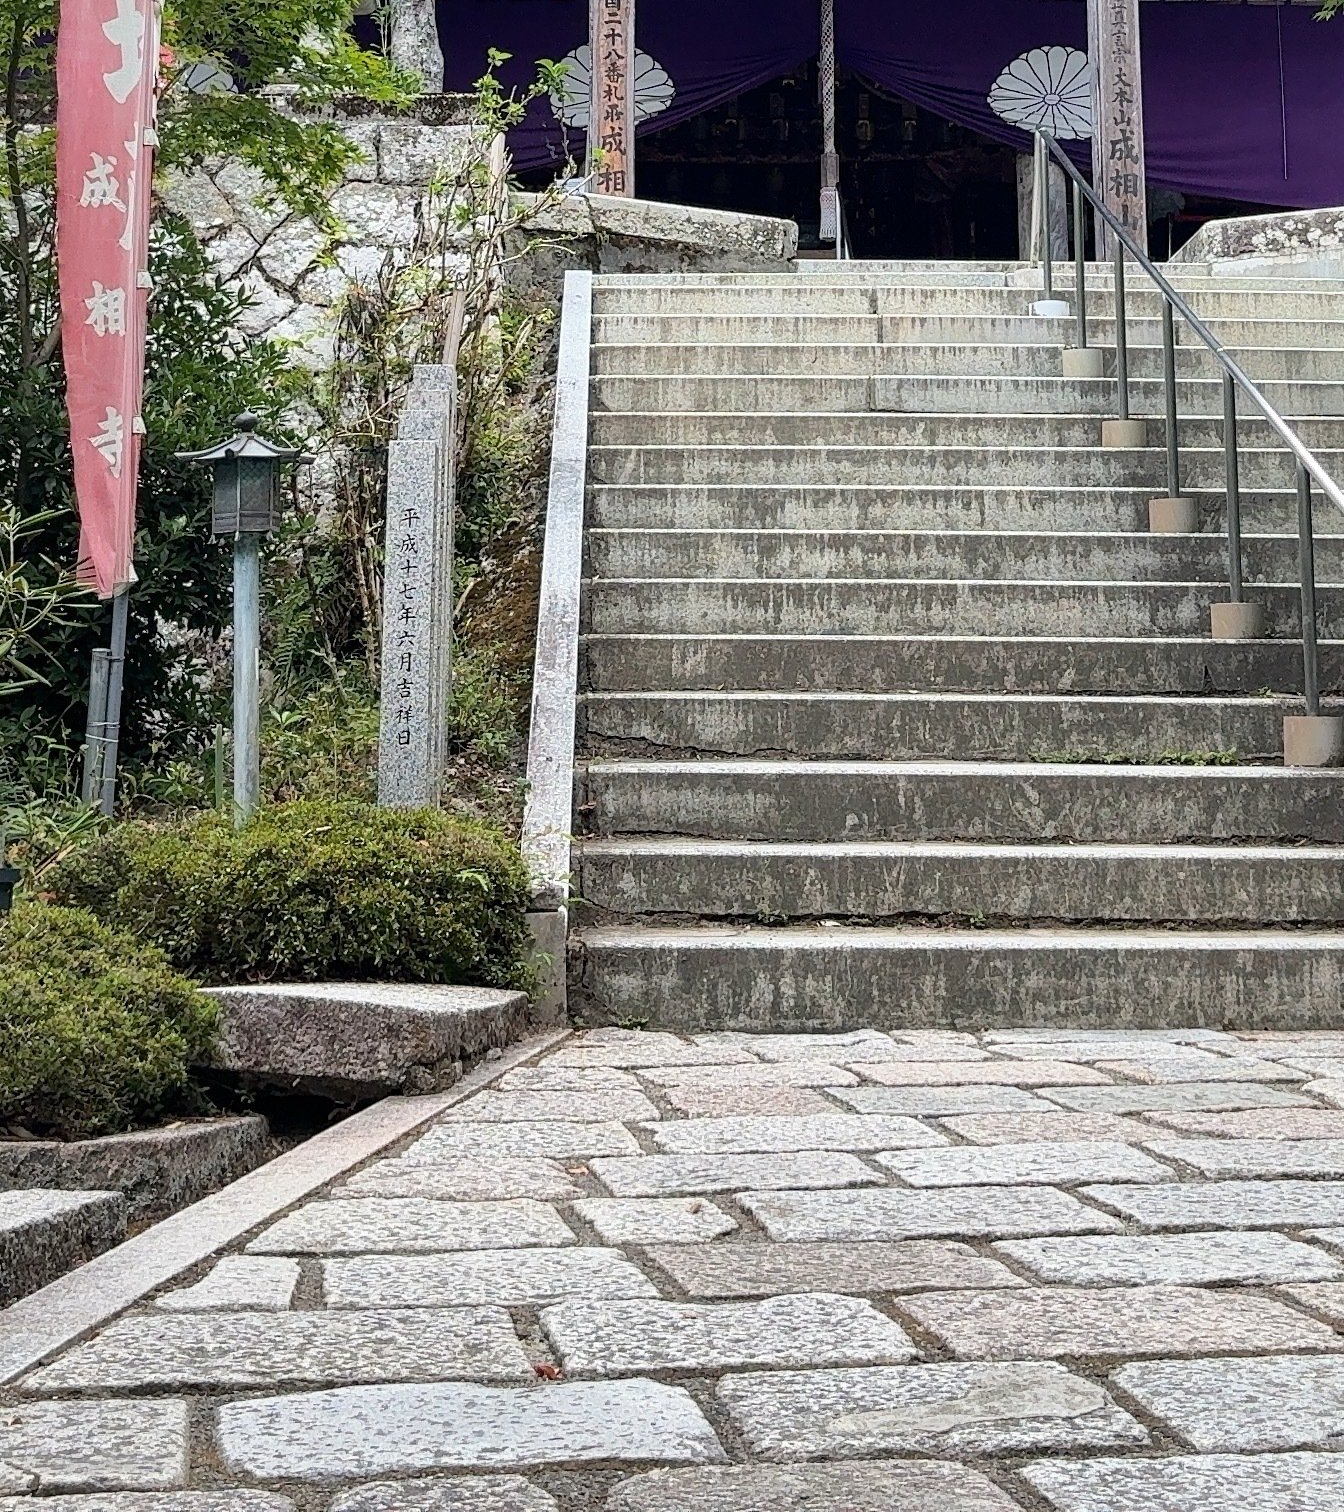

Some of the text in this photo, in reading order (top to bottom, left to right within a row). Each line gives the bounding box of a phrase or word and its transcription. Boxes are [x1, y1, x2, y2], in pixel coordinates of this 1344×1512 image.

[395, 508, 420, 747] 平成十七年六月吉祥日
